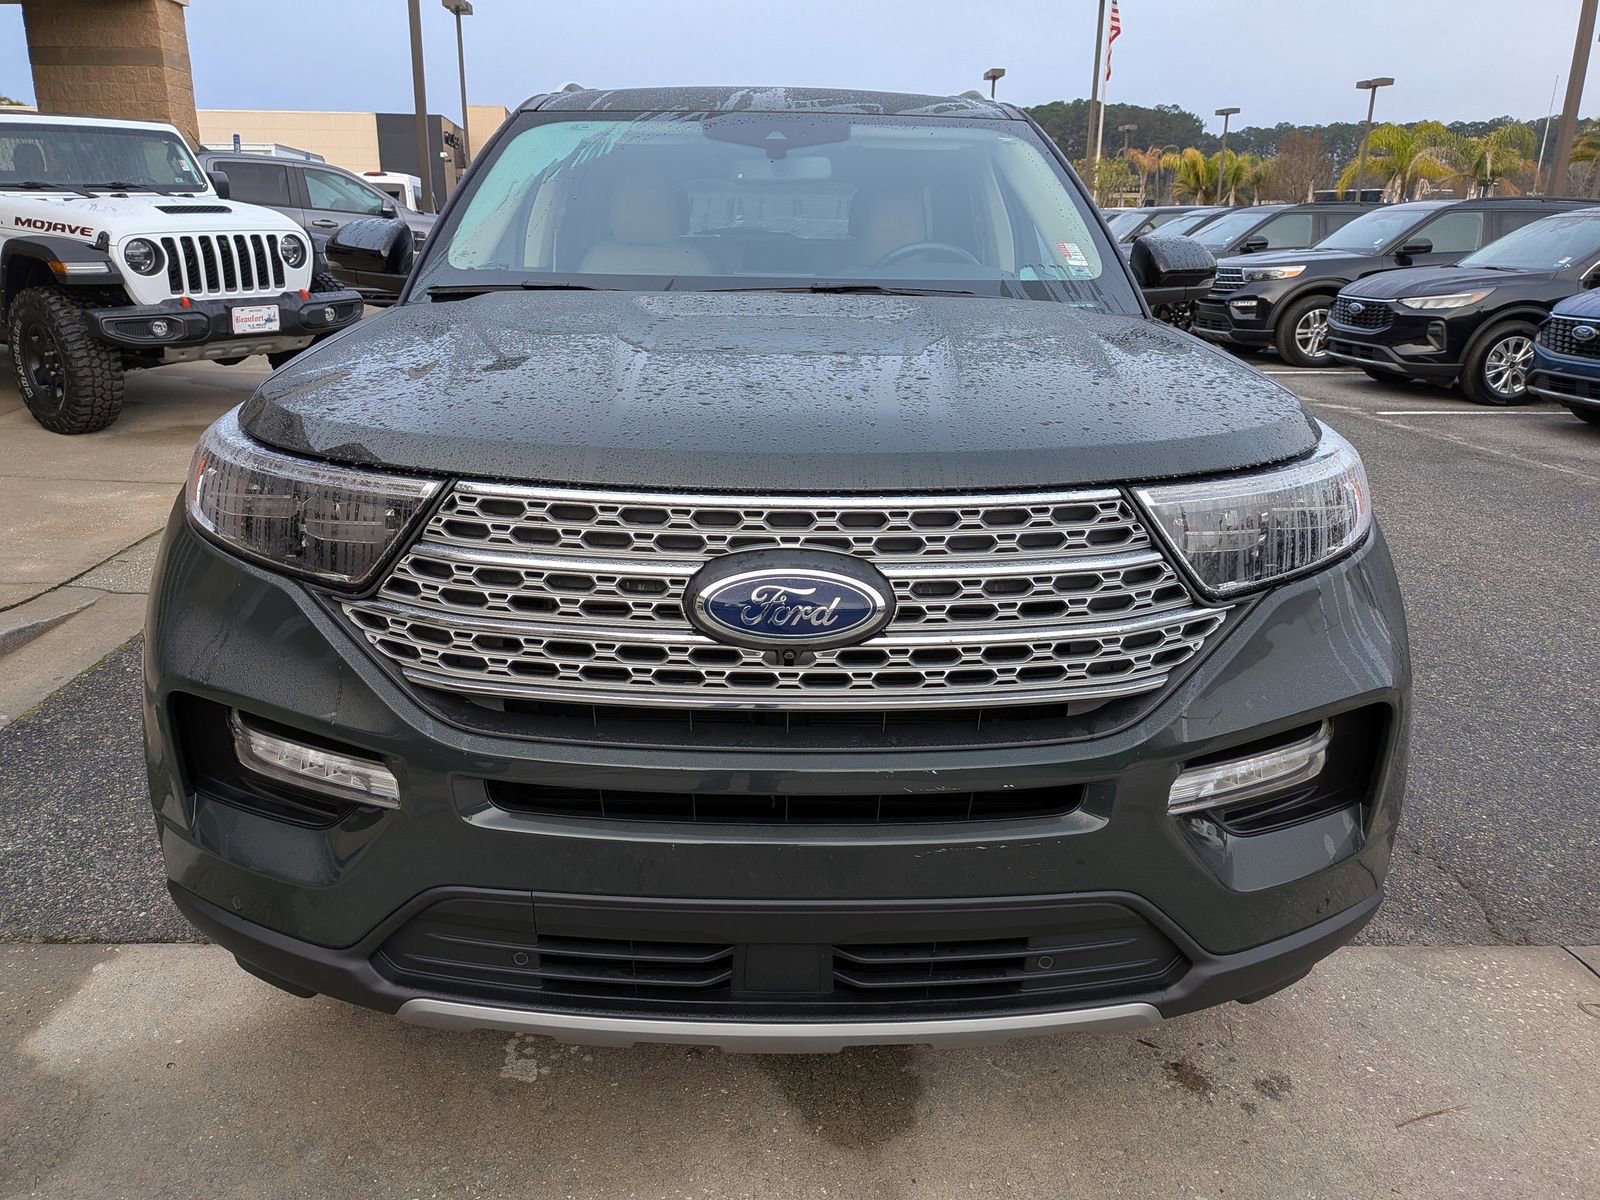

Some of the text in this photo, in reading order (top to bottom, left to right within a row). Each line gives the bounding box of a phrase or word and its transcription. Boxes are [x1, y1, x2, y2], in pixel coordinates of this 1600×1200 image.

[14, 216, 94, 237] MOJAVE
[234, 314, 264, 324] Beaufort
[740, 585, 841, 626] Ford
